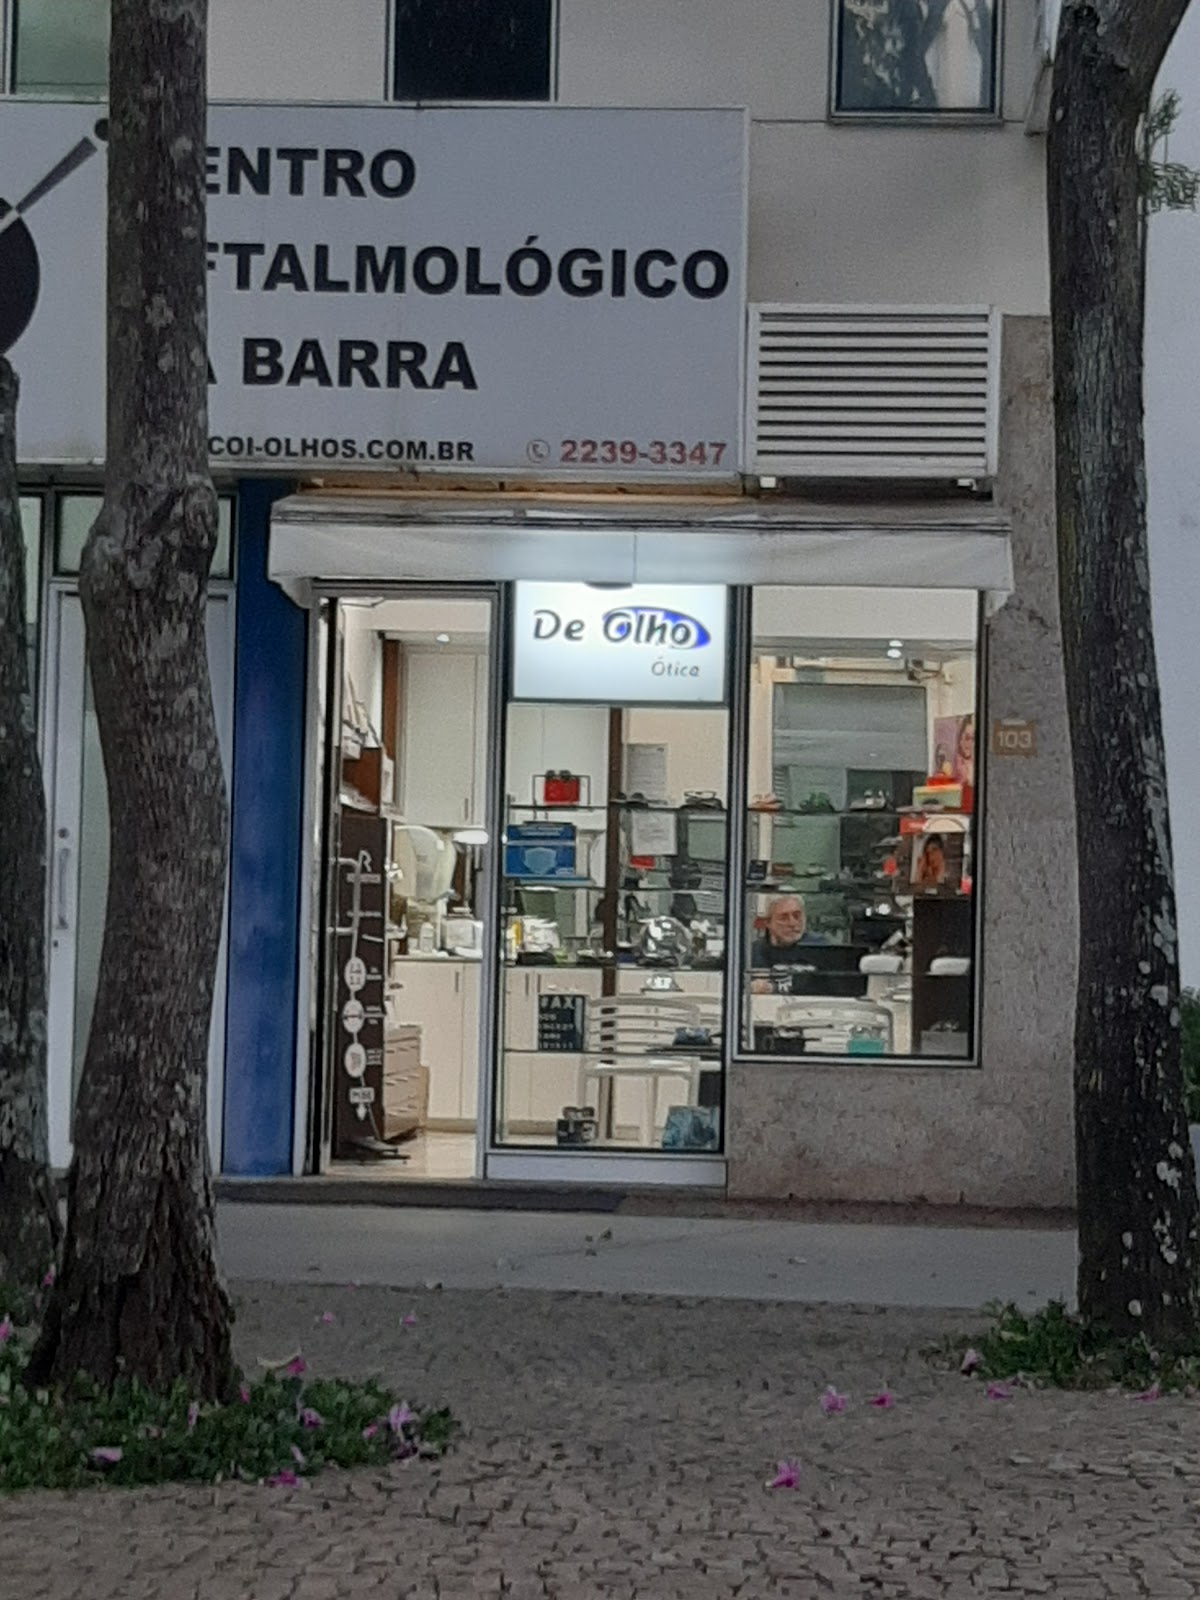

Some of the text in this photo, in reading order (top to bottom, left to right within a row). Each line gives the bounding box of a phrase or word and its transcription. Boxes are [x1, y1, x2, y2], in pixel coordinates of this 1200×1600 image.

[242, 337, 478, 391] BARRA
[560, 439, 727, 465] 2239-3347
[533, 609, 692, 646] De Olho
[651, 656, 700, 677] Ótica
[997, 731, 1032, 748] 103
